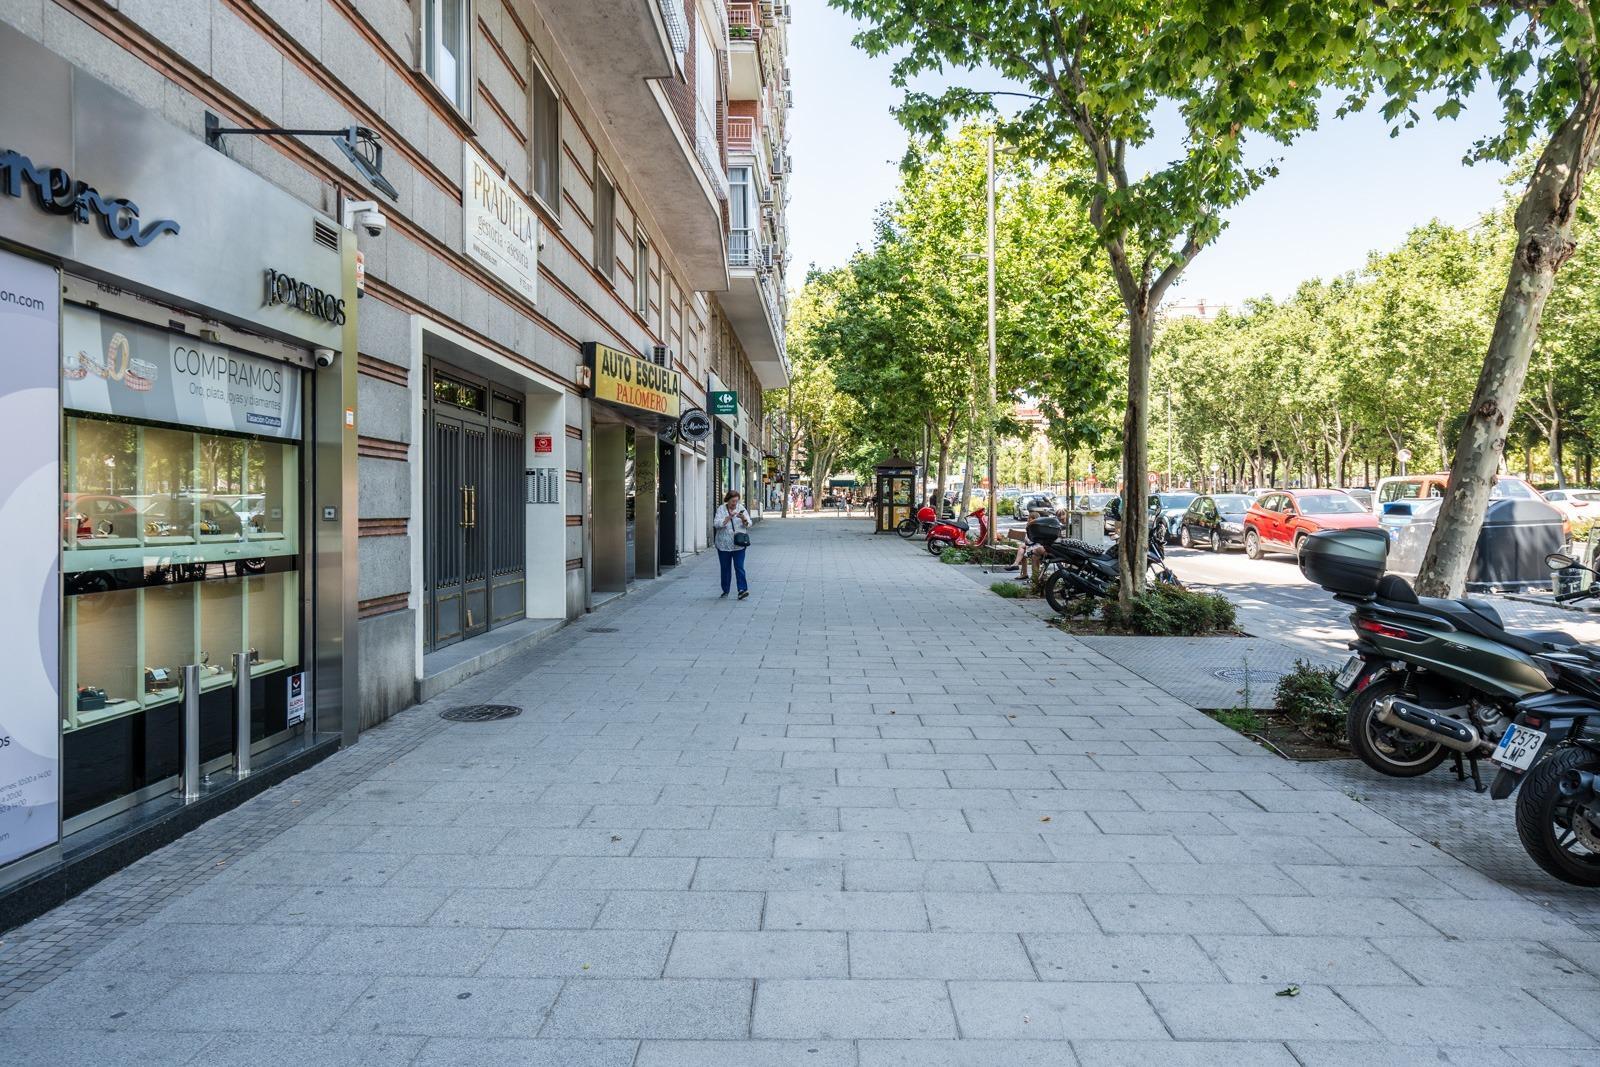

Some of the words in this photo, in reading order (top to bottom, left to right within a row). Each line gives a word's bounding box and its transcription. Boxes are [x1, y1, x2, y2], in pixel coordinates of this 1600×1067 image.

[473, 159, 533, 251] PRADILLA
[266, 267, 346, 326] JOYEROS
[174, 346, 281, 394] COMPRAMOS
[602, 349, 632, 382] AUTO
[636, 360, 679, 397] ESCUELA
[249, 394, 281, 410] diamantes
[616, 383, 668, 413] PALOMERO
[1503, 745, 1526, 762] LMP
[1511, 729, 1541, 750] 2573
